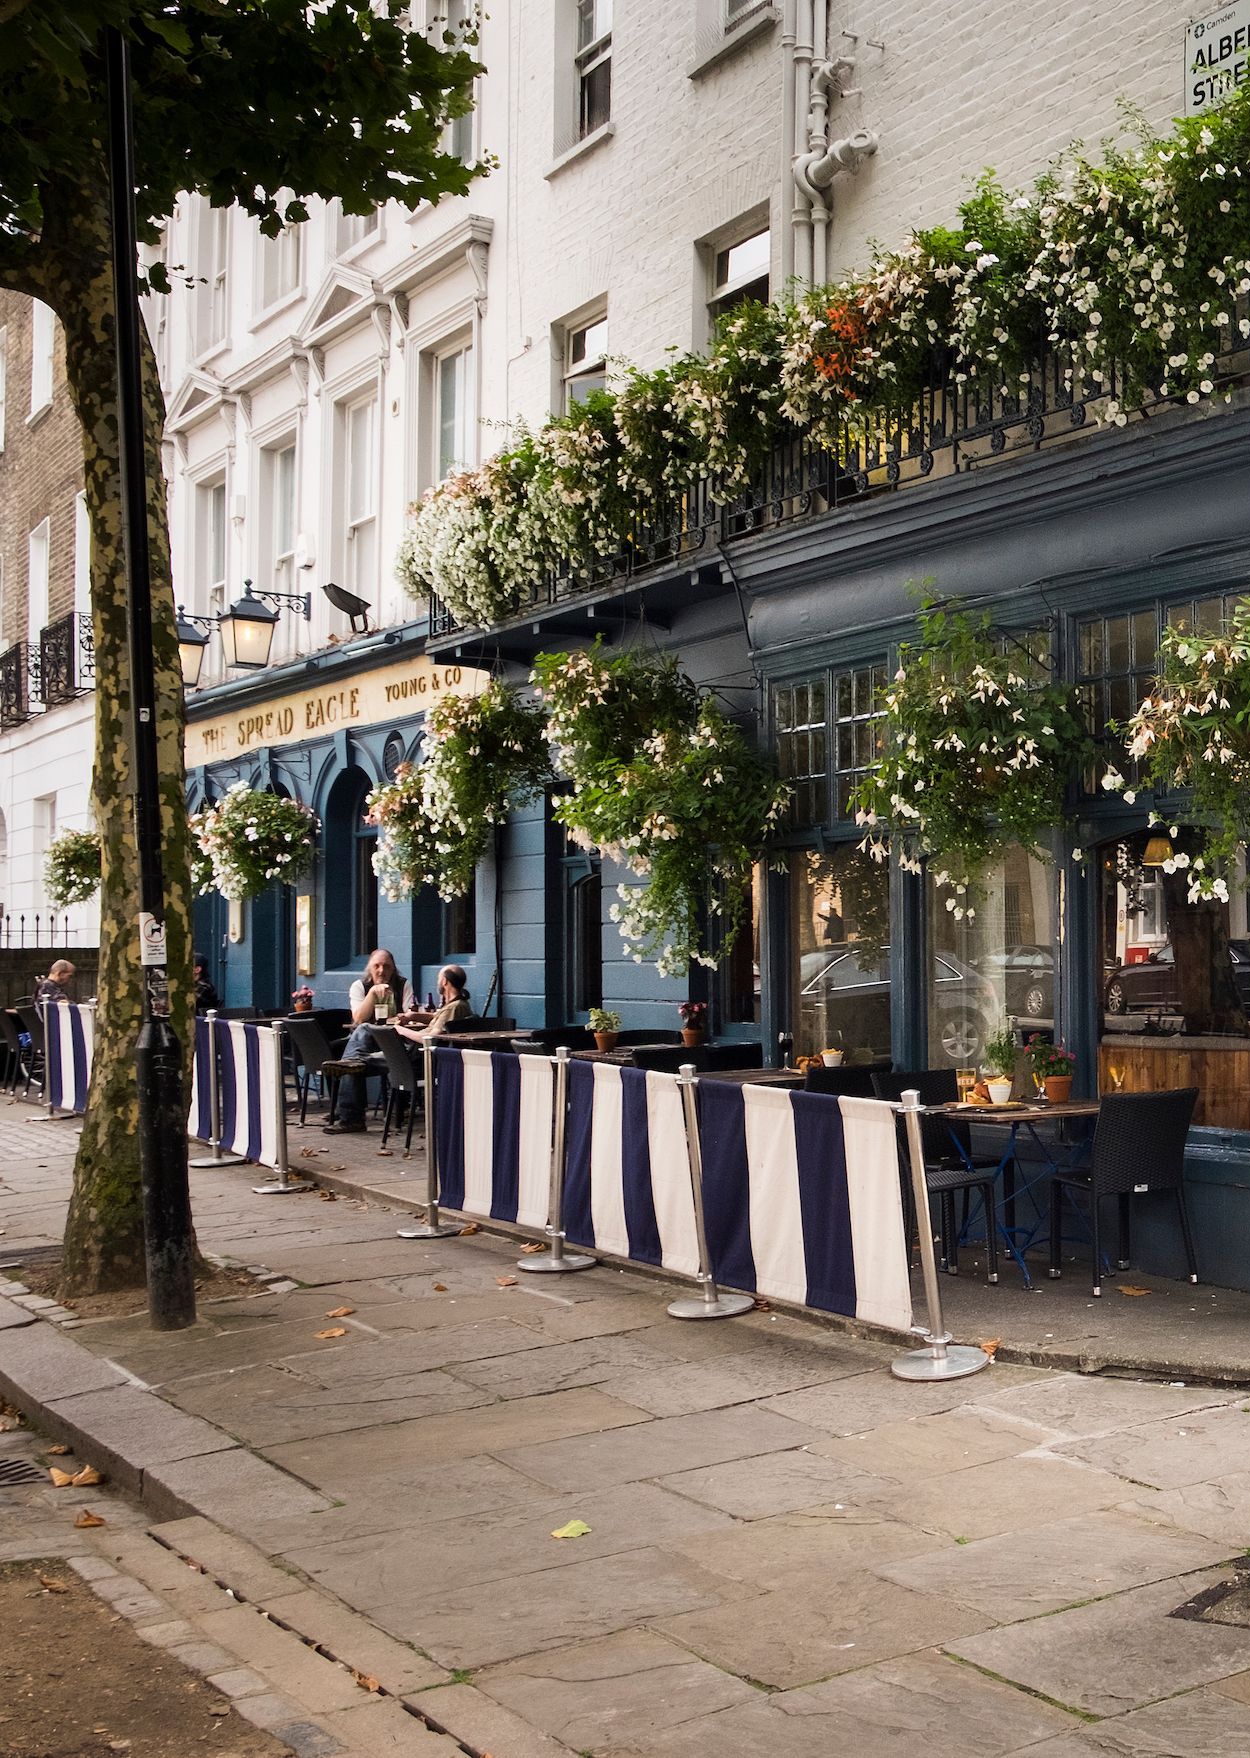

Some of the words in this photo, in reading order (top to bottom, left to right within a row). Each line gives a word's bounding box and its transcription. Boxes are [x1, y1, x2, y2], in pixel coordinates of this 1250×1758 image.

[1206, 10, 1236, 30] Camden
[202, 727, 227, 755] THE
[238, 706, 294, 746] SPREAD
[305, 687, 360, 730] EAGLE
[385, 675, 426, 703] YOUNG
[431, 673, 440, 691] &
[445, 666, 462, 687] CO
